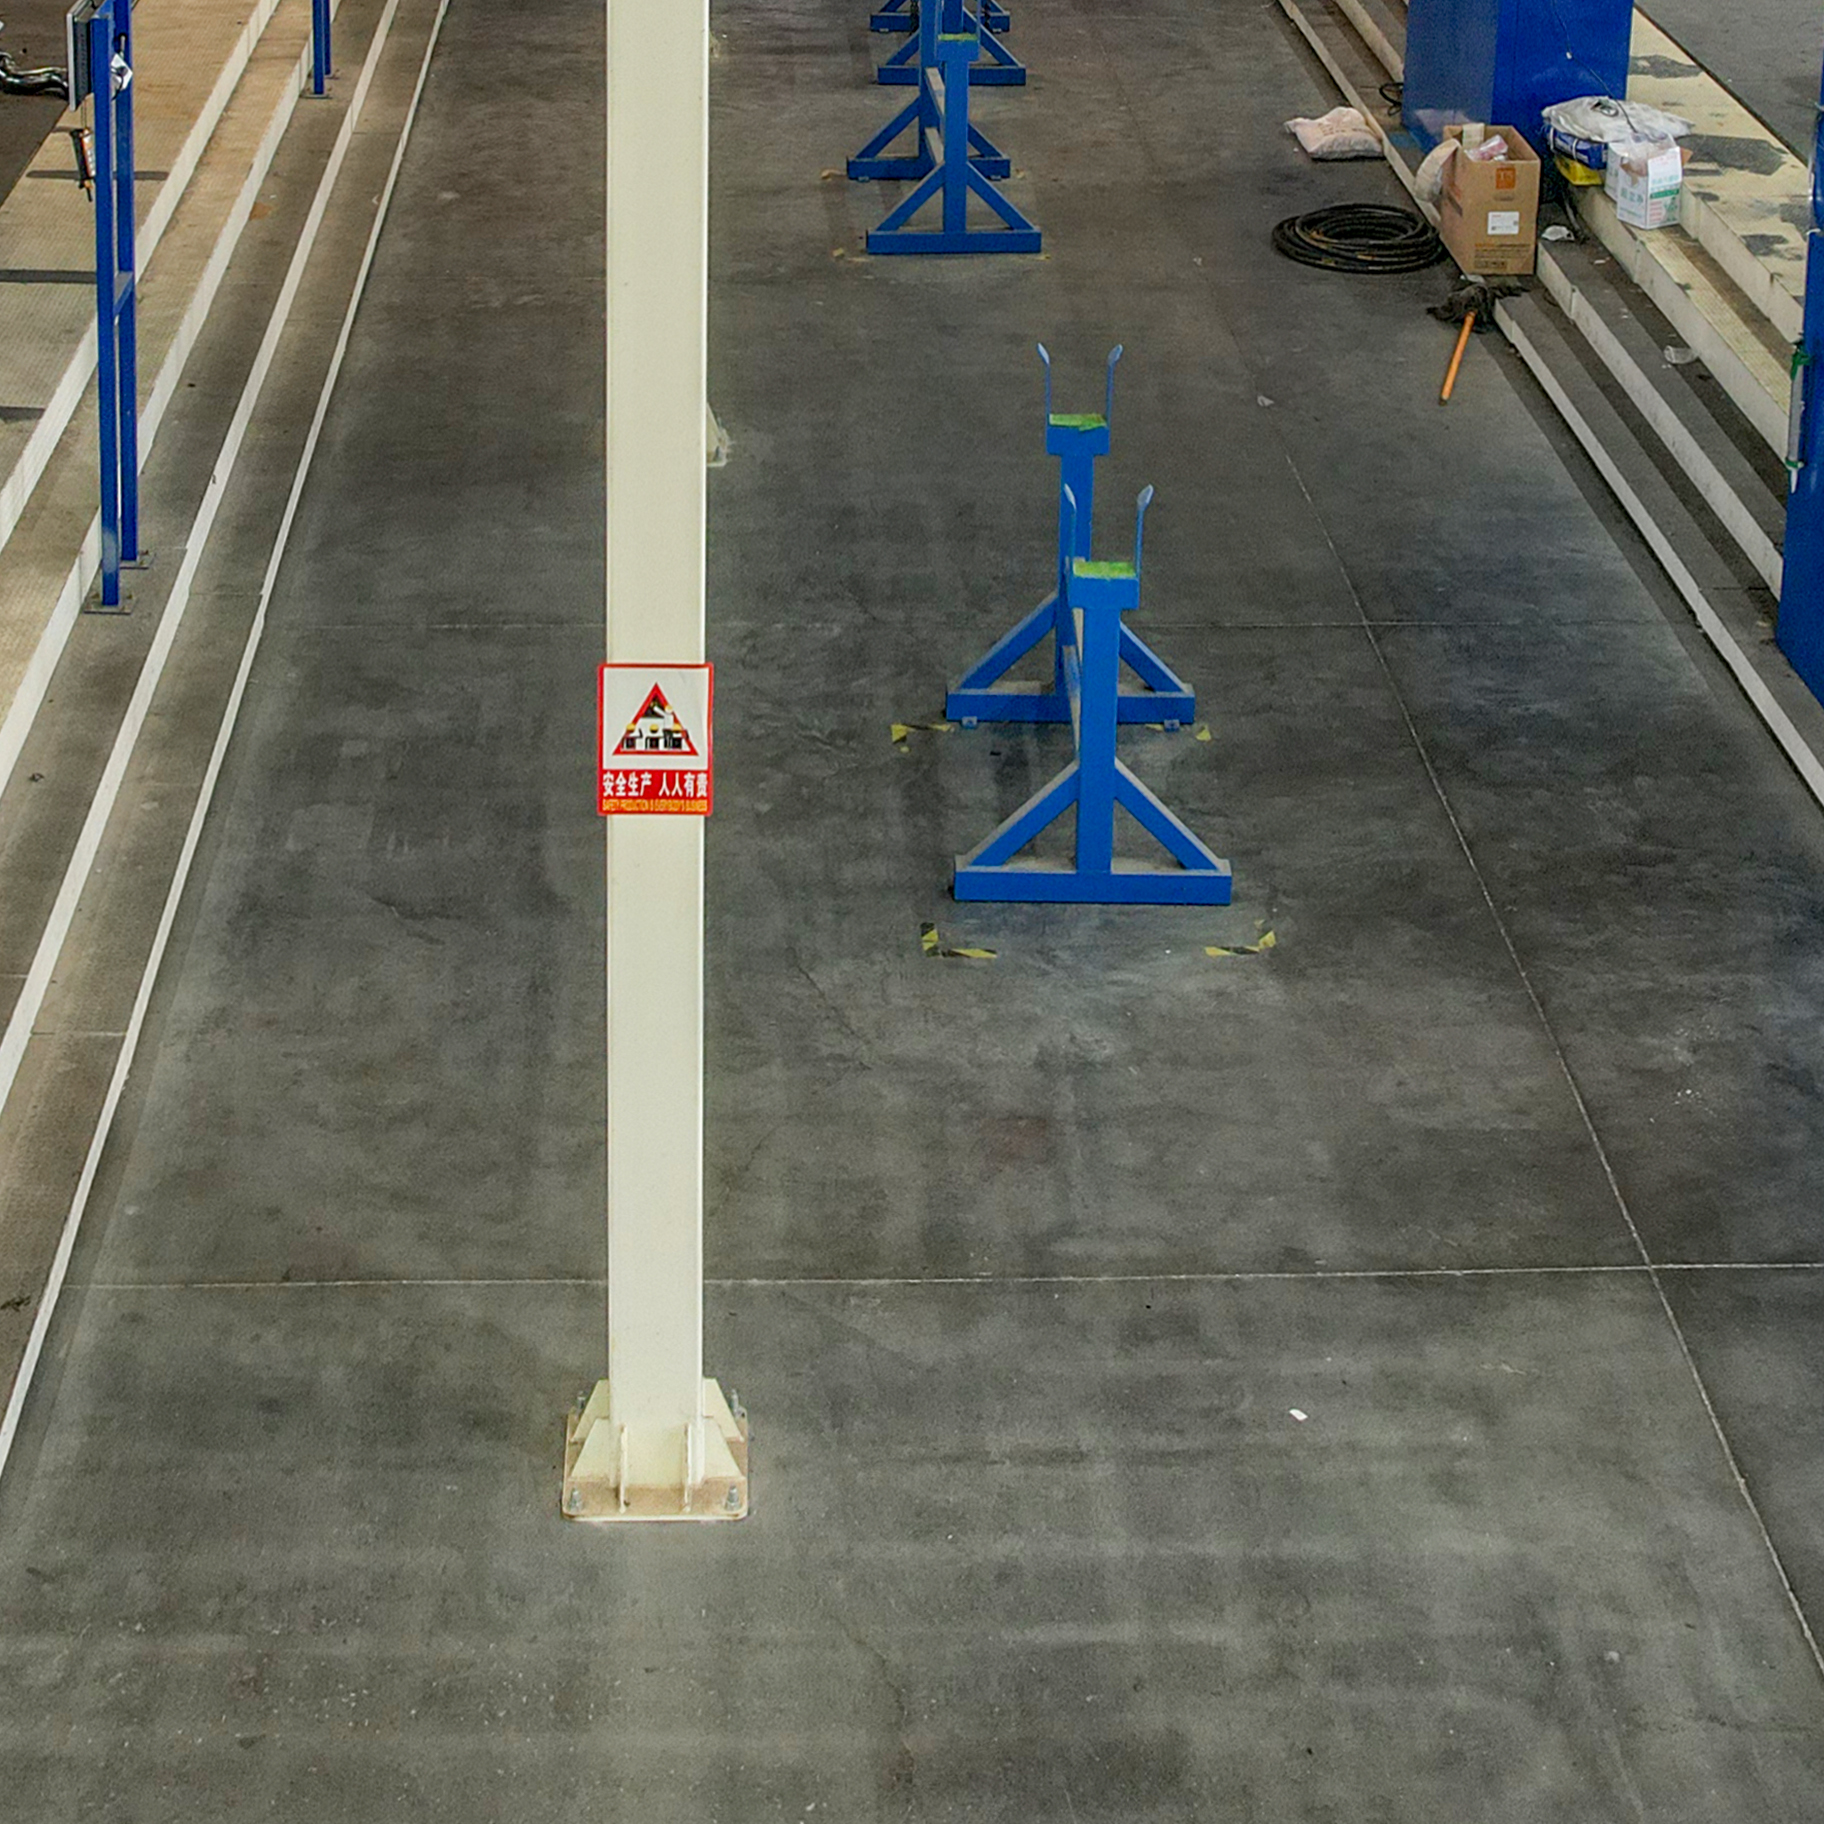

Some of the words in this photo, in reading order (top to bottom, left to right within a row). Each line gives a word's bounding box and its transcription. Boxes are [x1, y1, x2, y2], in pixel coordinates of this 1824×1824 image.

[603, 771, 652, 796] 安全生产
[658, 772, 707, 797] 人人有责
